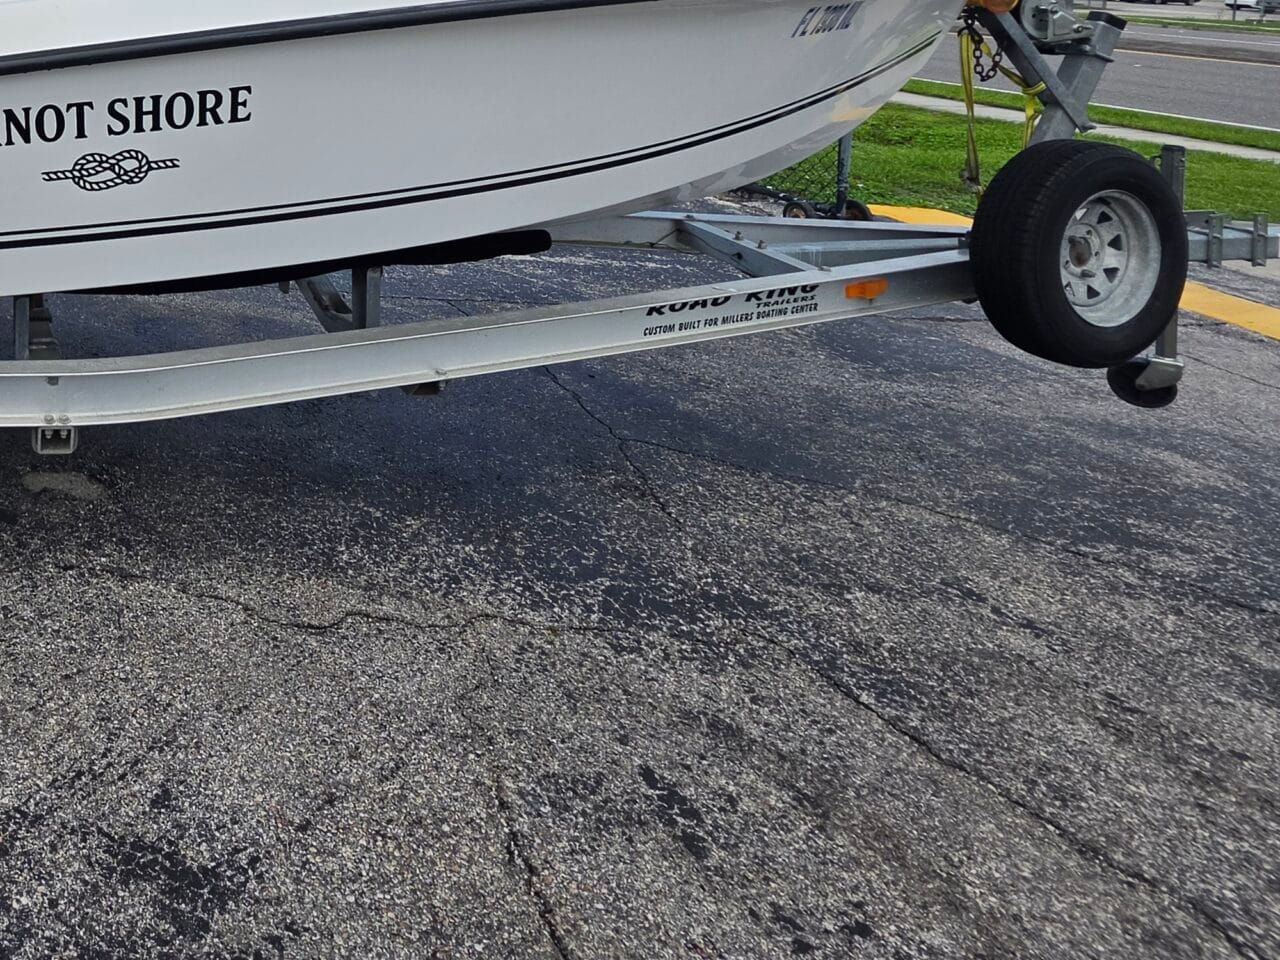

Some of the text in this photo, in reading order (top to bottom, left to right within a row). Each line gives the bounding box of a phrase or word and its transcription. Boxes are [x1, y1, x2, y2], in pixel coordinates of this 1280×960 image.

[106, 85, 253, 137] SHORE
[755, 294, 817, 309] TRAILERS
[643, 302, 819, 337] CUSTOM BUILT FOR MILLERS BOATING CENTER
